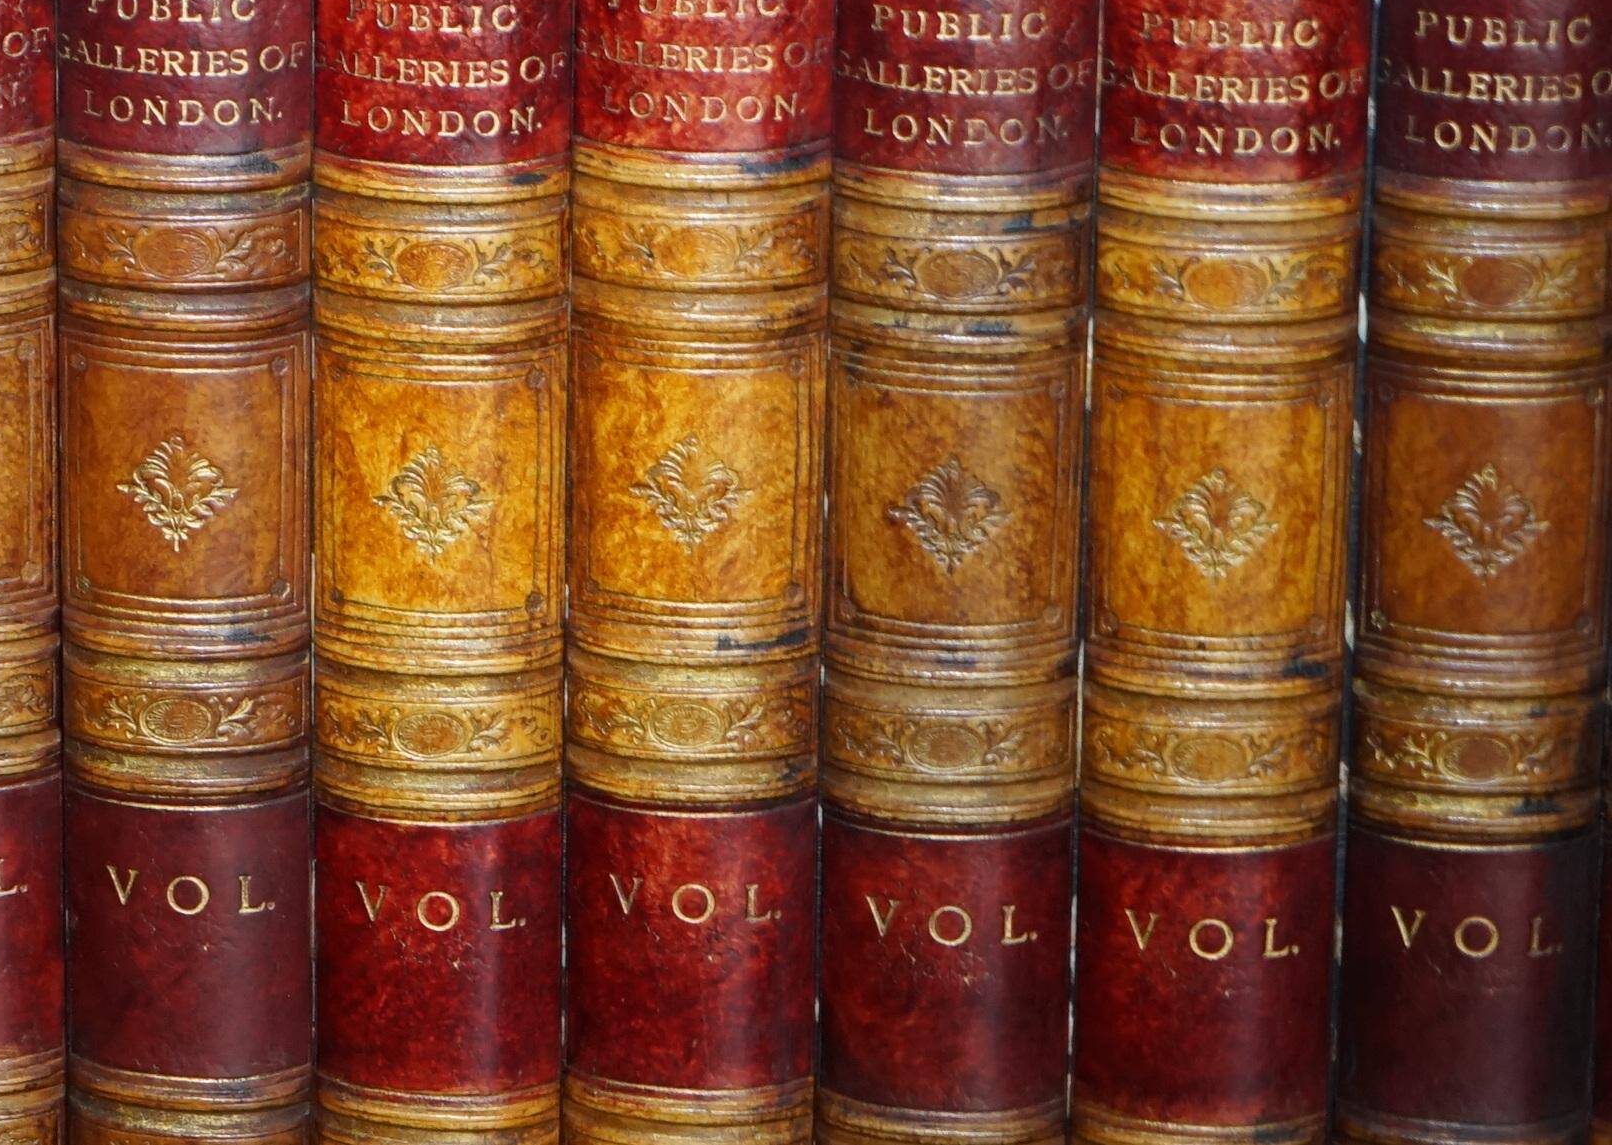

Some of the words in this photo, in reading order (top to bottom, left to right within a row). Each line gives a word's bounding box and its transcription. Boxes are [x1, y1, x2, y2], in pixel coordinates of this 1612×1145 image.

[871, 4, 1047, 41] PUBLIC
[1140, 12, 1319, 50] PUBLIC
[1415, 10, 1591, 48] PUBLIC
[2, 27, 49, 57] OF
[259, 41, 307, 72] OF
[783, 38, 829, 68] OF
[520, 52, 568, 83] OF
[1047, 58, 1094, 89] OF
[1319, 67, 1365, 99] OF
[84, 90, 283, 126] LONDON.
[341, 100, 542, 137] LONDON.
[603, 86, 805, 122] LONDON.
[1131, 117, 1340, 155] LONDON.
[106, 865, 275, 916] VOL.
[356, 882, 526, 932] VOL.
[609, 873, 781, 924] VOL.
[866, 896, 1037, 946] VOL.
[1125, 909, 1300, 960] VOL.
[1390, 906, 1563, 958] VOL.
